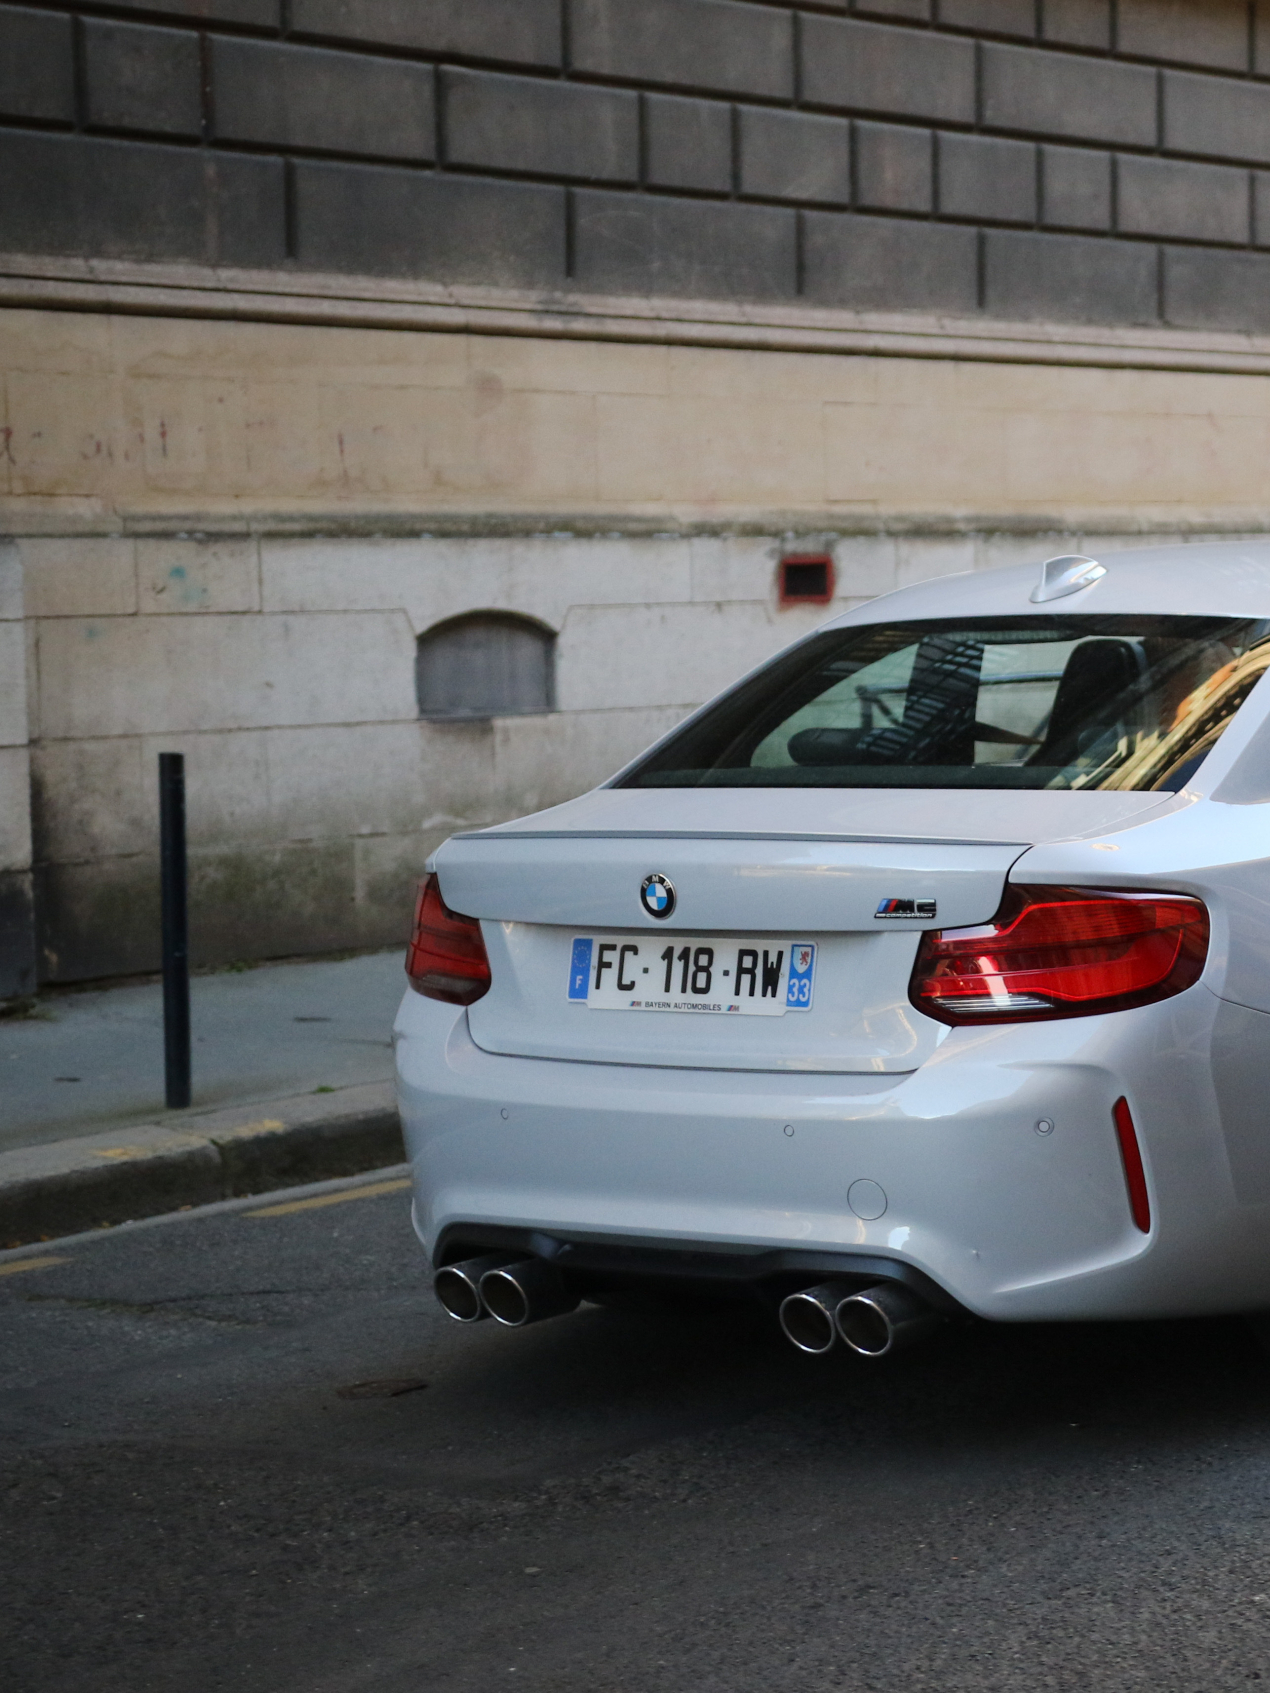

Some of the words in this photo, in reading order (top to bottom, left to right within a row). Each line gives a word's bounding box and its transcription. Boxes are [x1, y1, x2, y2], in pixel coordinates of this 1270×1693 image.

[641, 874, 672, 890] BMW
[575, 975, 583, 989] F
[788, 978, 810, 1002] 33
[645, 1001, 671, 1009] BAYERN
[673, 1003, 722, 1011] AUTOMOBILES
